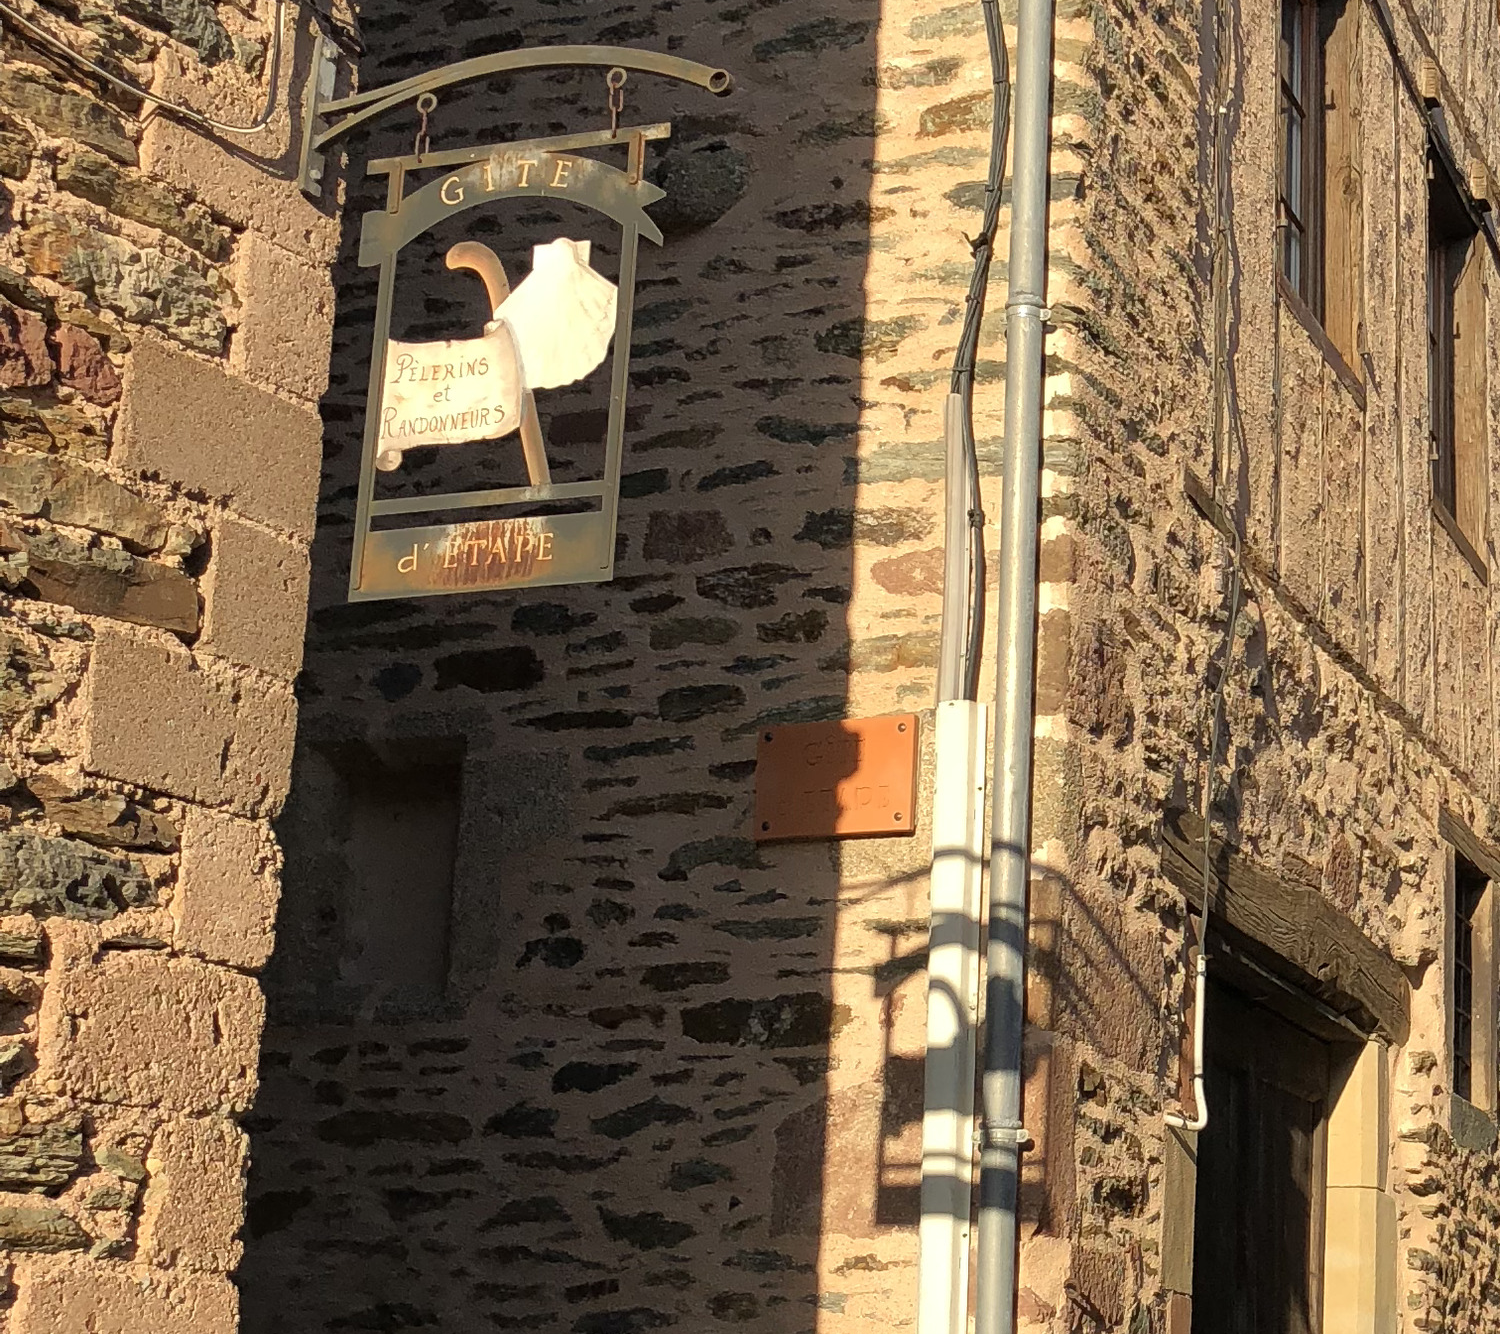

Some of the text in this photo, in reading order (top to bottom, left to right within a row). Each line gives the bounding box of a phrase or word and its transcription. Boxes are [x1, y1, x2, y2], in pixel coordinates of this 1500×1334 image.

[440, 159, 573, 206] GITE
[432, 384, 451, 403] et
[381, 405, 506, 440] RANDONNEURS
